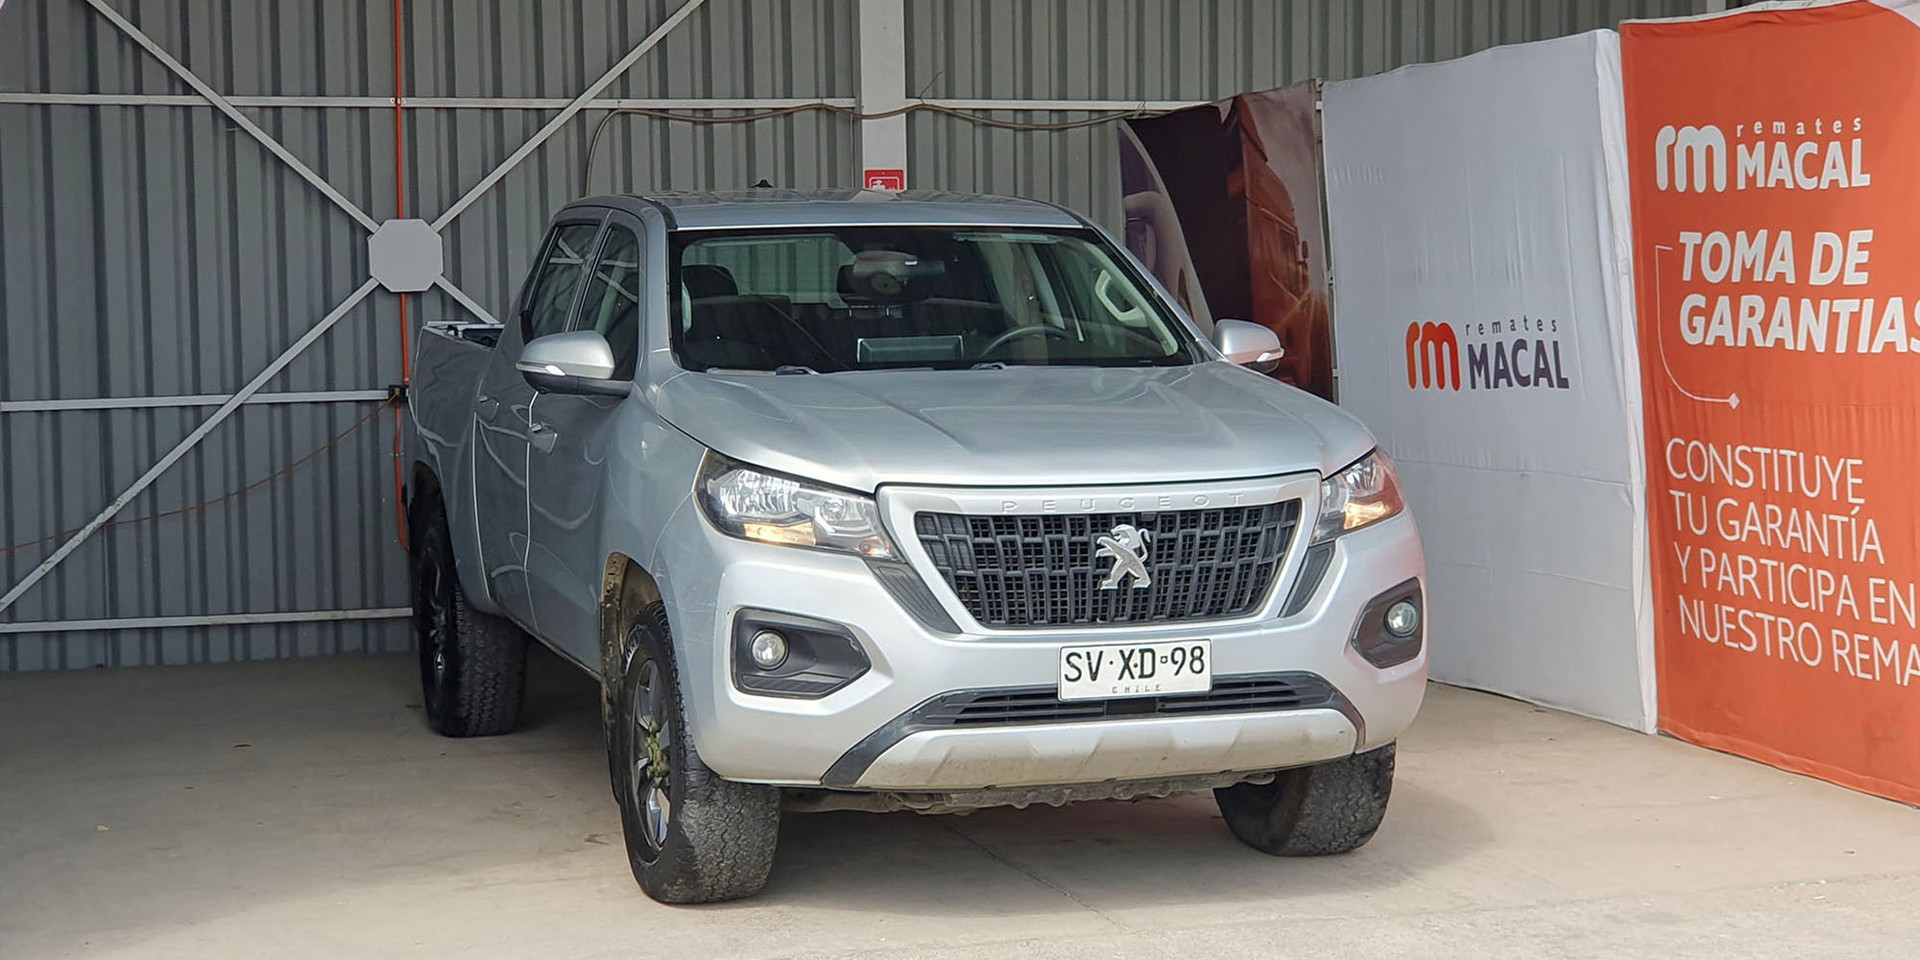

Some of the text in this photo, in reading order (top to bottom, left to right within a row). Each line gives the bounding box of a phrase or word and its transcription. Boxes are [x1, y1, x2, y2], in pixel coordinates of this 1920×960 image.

[1736, 117, 1862, 137] remates
[1736, 138, 1871, 190] MACAL
[1679, 229, 1874, 286] TOMA DE
[1465, 315, 1558, 336] remates
[1467, 338, 1570, 390] MACAL
[1665, 437, 1865, 504] CONSTITUYE
[1002, 493, 1245, 514] PEUGEOT
[1669, 489, 1885, 565] TU GARANTÍA
[1673, 541, 1917, 629] Y PARTICIPA EN
[1678, 594, 1920, 687] NUESTRO REMA
[1111, 683, 1162, 695] CHILE
